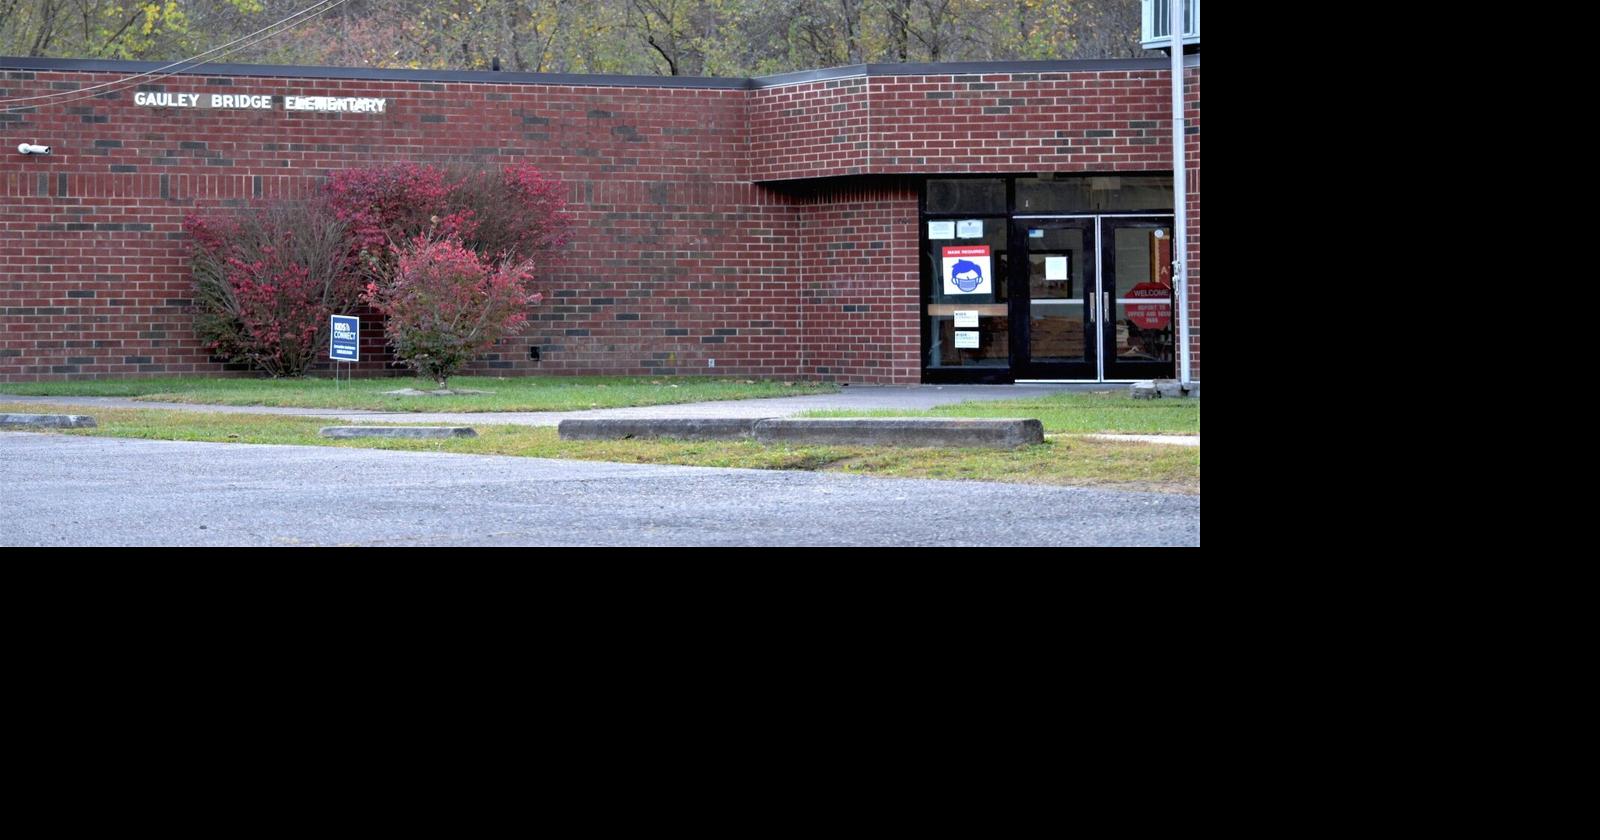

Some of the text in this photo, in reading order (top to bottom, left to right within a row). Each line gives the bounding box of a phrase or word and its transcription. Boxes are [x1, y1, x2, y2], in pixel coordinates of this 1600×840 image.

[134, 92, 386, 113] GAULEY BRIDGE ELEMENTARY
[1133, 289, 1169, 297] WELCOME
[334, 331, 356, 340] CONNECT
